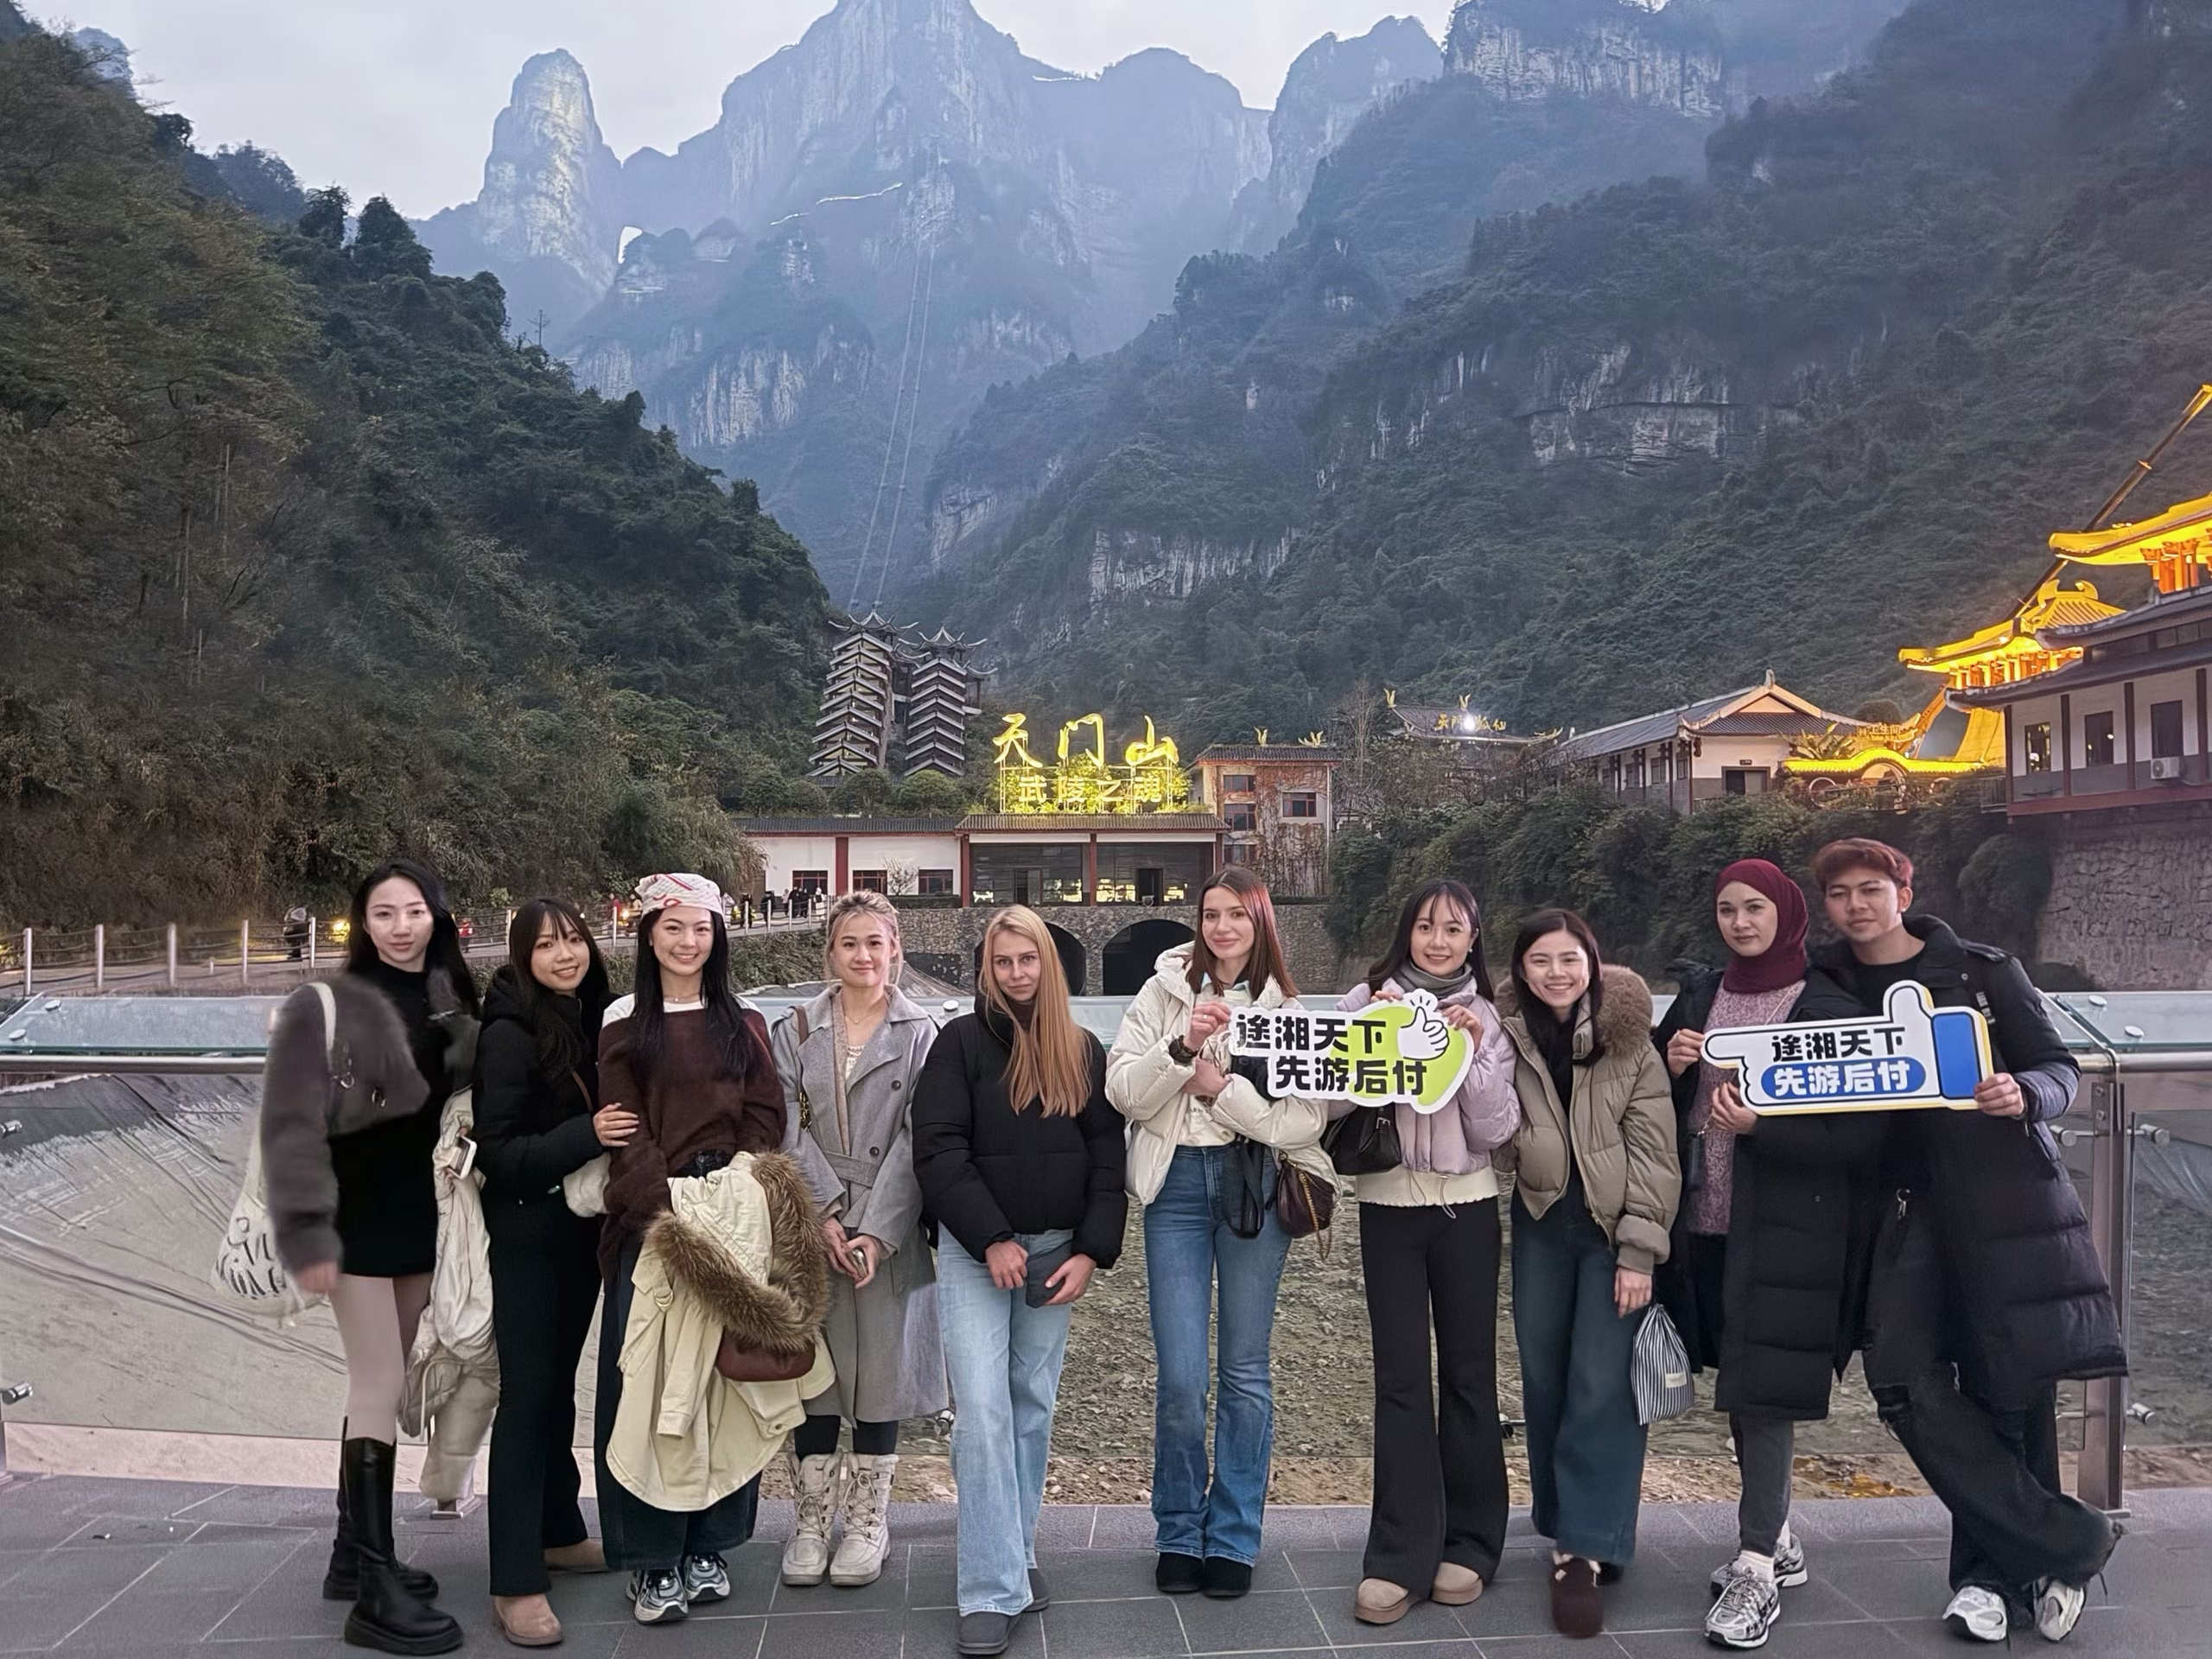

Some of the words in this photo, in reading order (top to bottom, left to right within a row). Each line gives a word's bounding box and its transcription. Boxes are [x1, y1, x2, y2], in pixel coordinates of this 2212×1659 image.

[993, 713, 1179, 768] 天门山
[1019, 775, 1162, 803] 武陵之魂
[1236, 1014, 1387, 1053] 途湘天下
[1771, 1027, 1905, 1063] 途湘天下
[1275, 1056, 1427, 1096] 先游后付
[1774, 1061, 1910, 1096] 先游后付
